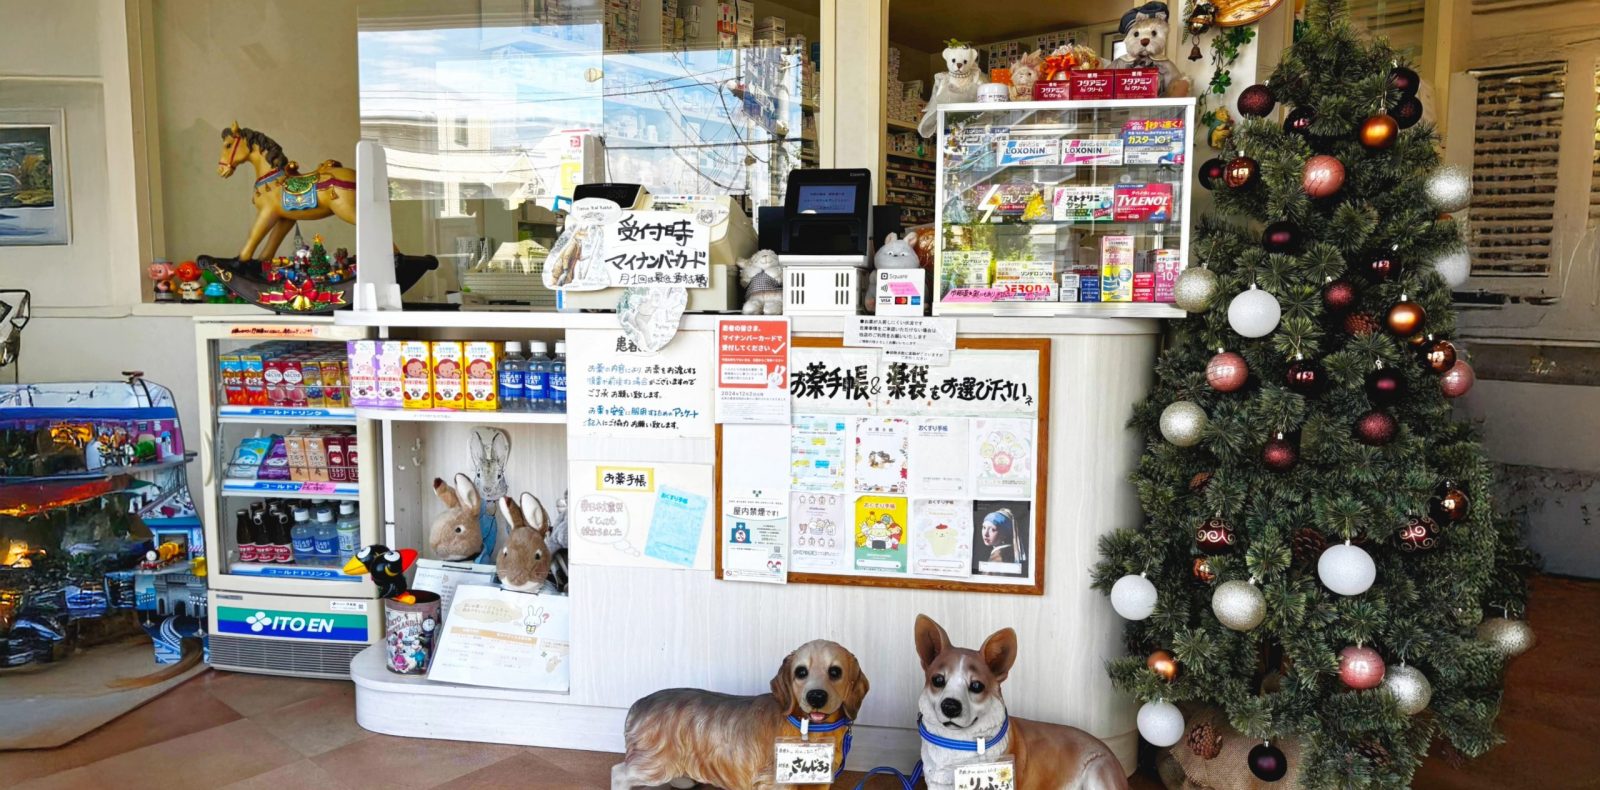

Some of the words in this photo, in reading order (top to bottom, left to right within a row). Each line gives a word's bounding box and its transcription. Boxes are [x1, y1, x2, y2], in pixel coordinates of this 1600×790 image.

[1076, 79, 1108, 87] フタアミン
[1121, 77, 1152, 86] フタアミン
[1066, 194, 1100, 202] ストナリニ
[1117, 194, 1168, 207] TYLENOL
[618, 214, 694, 247] 受付時
[605, 250, 707, 271] マイナンバーカード
[1161, 272, 1173, 281] 10
[615, 335, 647, 352] 患者
[721, 344, 770, 352] 受付してください
[604, 472, 647, 487] お薬手帳
[733, 506, 779, 517] 屋内禁煙です!
[271, 615, 306, 632] ITO
[307, 618, 335, 633] EN
